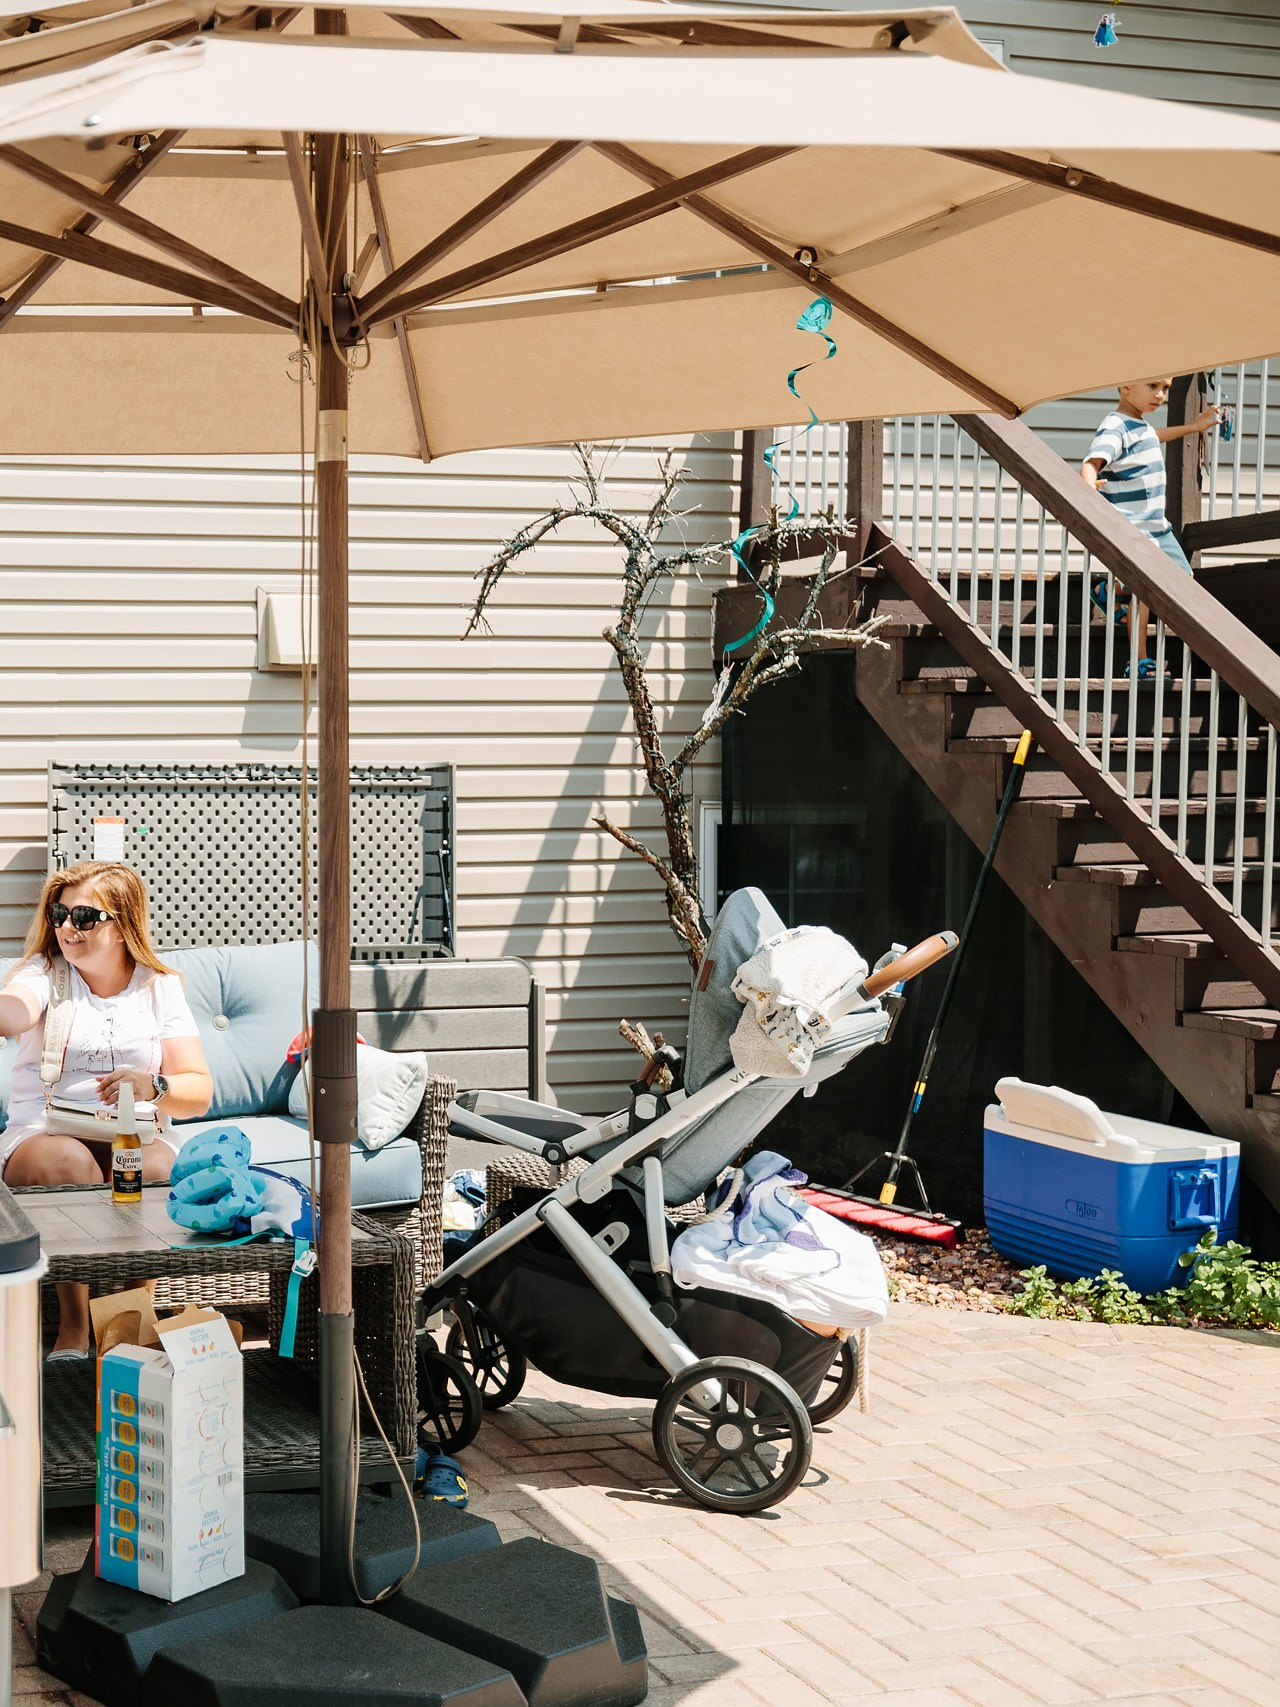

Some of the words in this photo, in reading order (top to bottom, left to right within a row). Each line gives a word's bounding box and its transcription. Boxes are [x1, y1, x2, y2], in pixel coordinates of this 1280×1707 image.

[115, 1155, 141, 1165] Corona
[191, 1333, 209, 1343] SELTZER
[203, 1509, 218, 1519] VODKA
[201, 1515, 220, 1527] SELTZER
